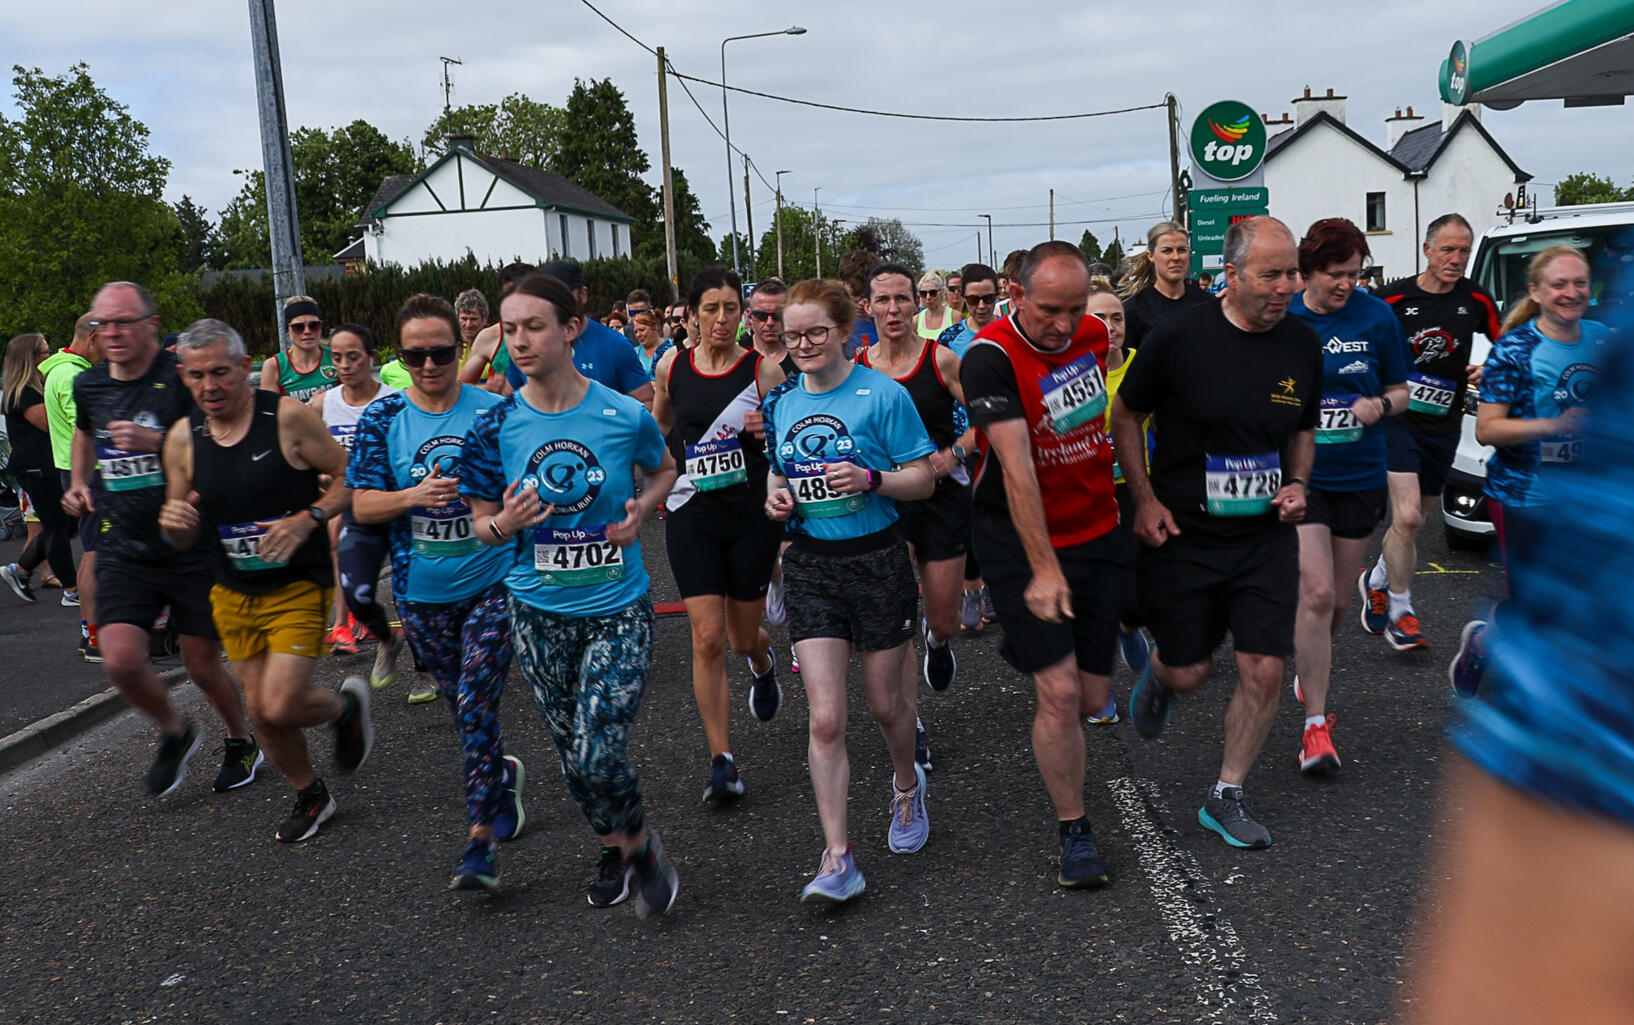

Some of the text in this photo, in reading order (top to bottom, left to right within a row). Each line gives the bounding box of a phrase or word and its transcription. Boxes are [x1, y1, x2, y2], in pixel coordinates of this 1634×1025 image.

[1451, 72, 1465, 94] top
[1204, 141, 1253, 166] top
[1200, 192, 1260, 204] Fueling Ireland
[1062, 367, 1103, 408] 4551
[1414, 386, 1452, 406] 4742
[1553, 390, 1568, 400] 20
[792, 416, 843, 434] COLM HORKAN
[420, 437, 465, 455] COLM HORK
[533, 441, 589, 464] COLM HORKAN
[694, 443, 717, 454] Pop Up
[781, 446, 794, 454] 20
[836, 440, 853, 451] 23
[410, 467, 427, 477] 20
[697, 450, 742, 476] 4750
[795, 463, 824, 474] Pop Up
[587, 470, 604, 482] 23
[1224, 471, 1280, 498] 4728
[798, 478, 842, 501] 489
[577, 494, 593, 510] RUN
[426, 518, 471, 540] 470
[553, 530, 586, 541] Pop Up
[553, 541, 620, 569] 4702
